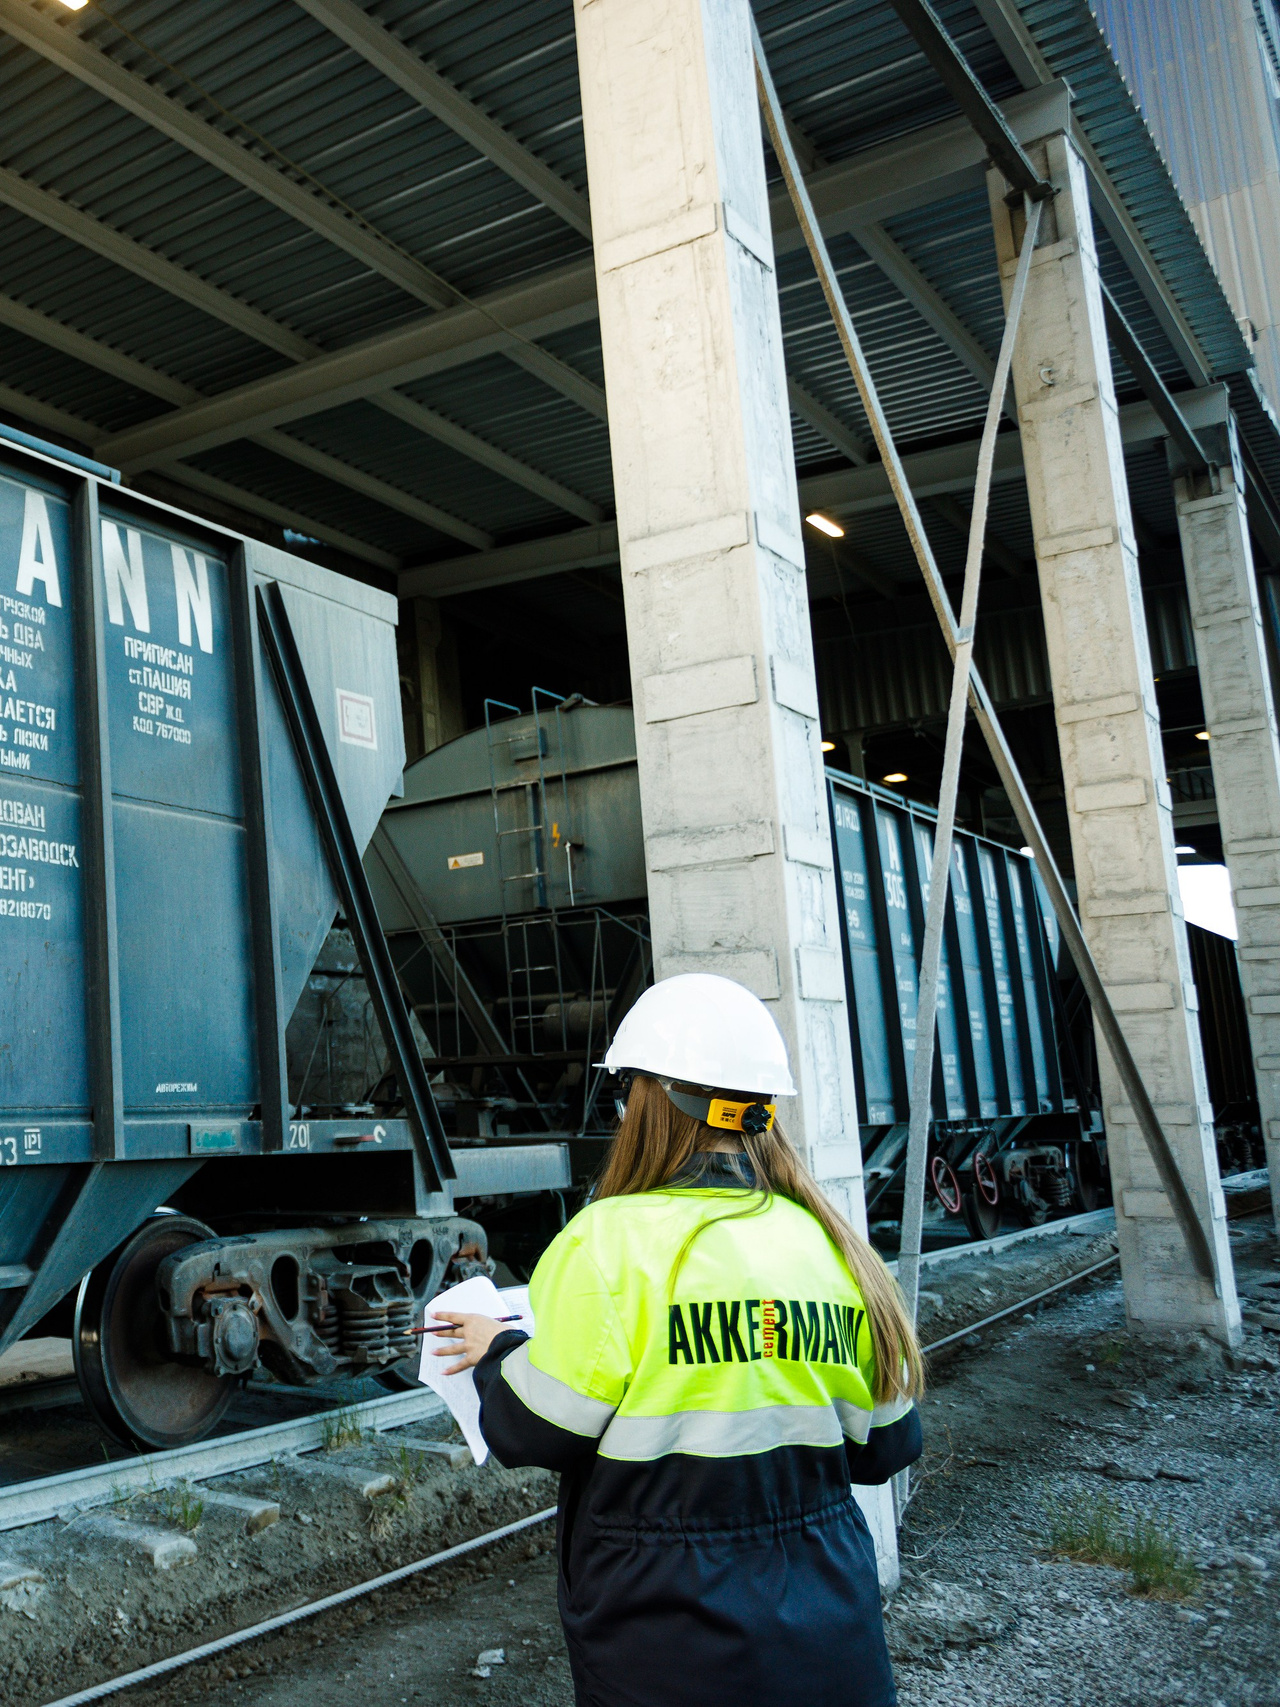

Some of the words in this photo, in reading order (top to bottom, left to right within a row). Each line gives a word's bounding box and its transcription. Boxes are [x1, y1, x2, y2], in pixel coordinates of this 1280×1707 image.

[13, 626, 44, 652] ДВА
[124, 635, 193, 676] ПРИПИСАН
[138, 691, 164, 716] СВР
[13, 727, 49, 752] ЛЮКИ
[132, 715, 154, 735] КОД
[155, 721, 191, 745] 767000
[762, 1299, 775, 1358] cement
